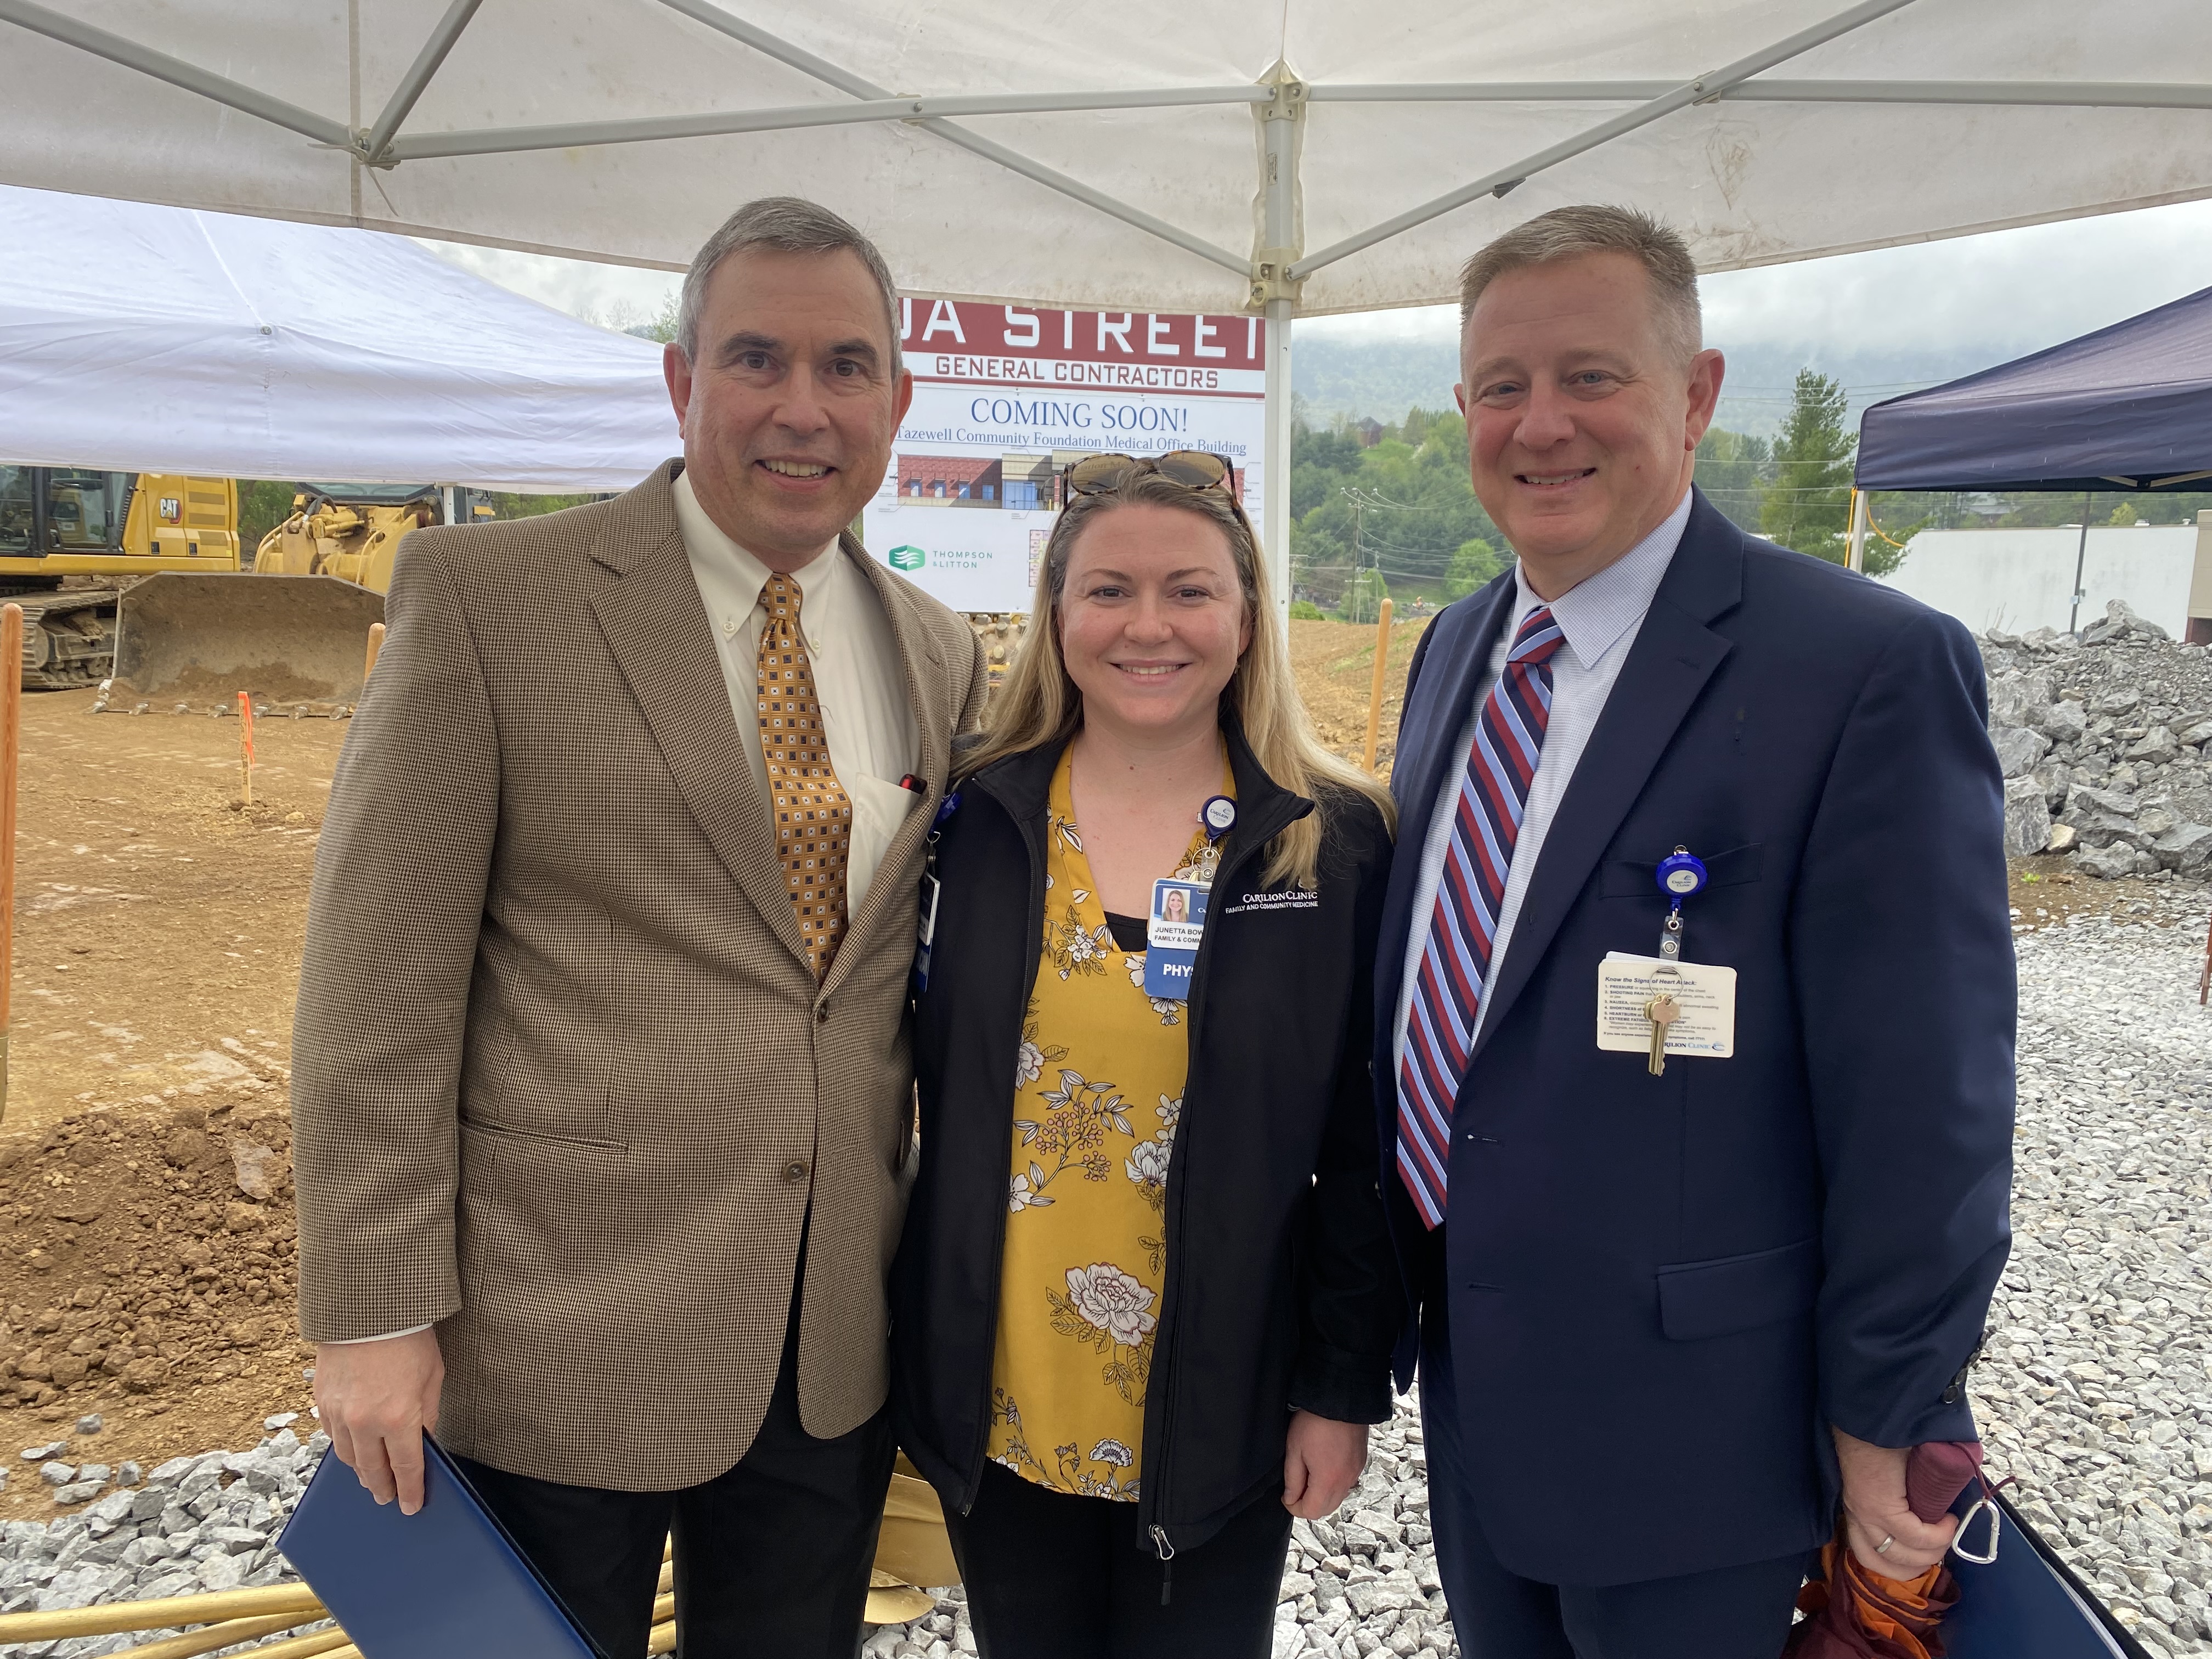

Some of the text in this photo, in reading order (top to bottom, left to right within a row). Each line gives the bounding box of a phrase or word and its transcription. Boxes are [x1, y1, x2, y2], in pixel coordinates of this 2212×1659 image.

[1003, 305, 1265, 359] STREET
[936, 356, 1218, 388] GENERAL CONTRACTORS
[971, 398, 1187, 432] COMING SOON!
[897, 426, 1247, 456] Tazewell Community Foundation Medical Office Building
[160, 498, 178, 518] CAT
[933, 550, 993, 559] THOMPSON
[1225, 905, 1245, 914] FAMILY
[1246, 903, 1259, 911] AND
[1259, 901, 1292, 910] COMMUNITY
